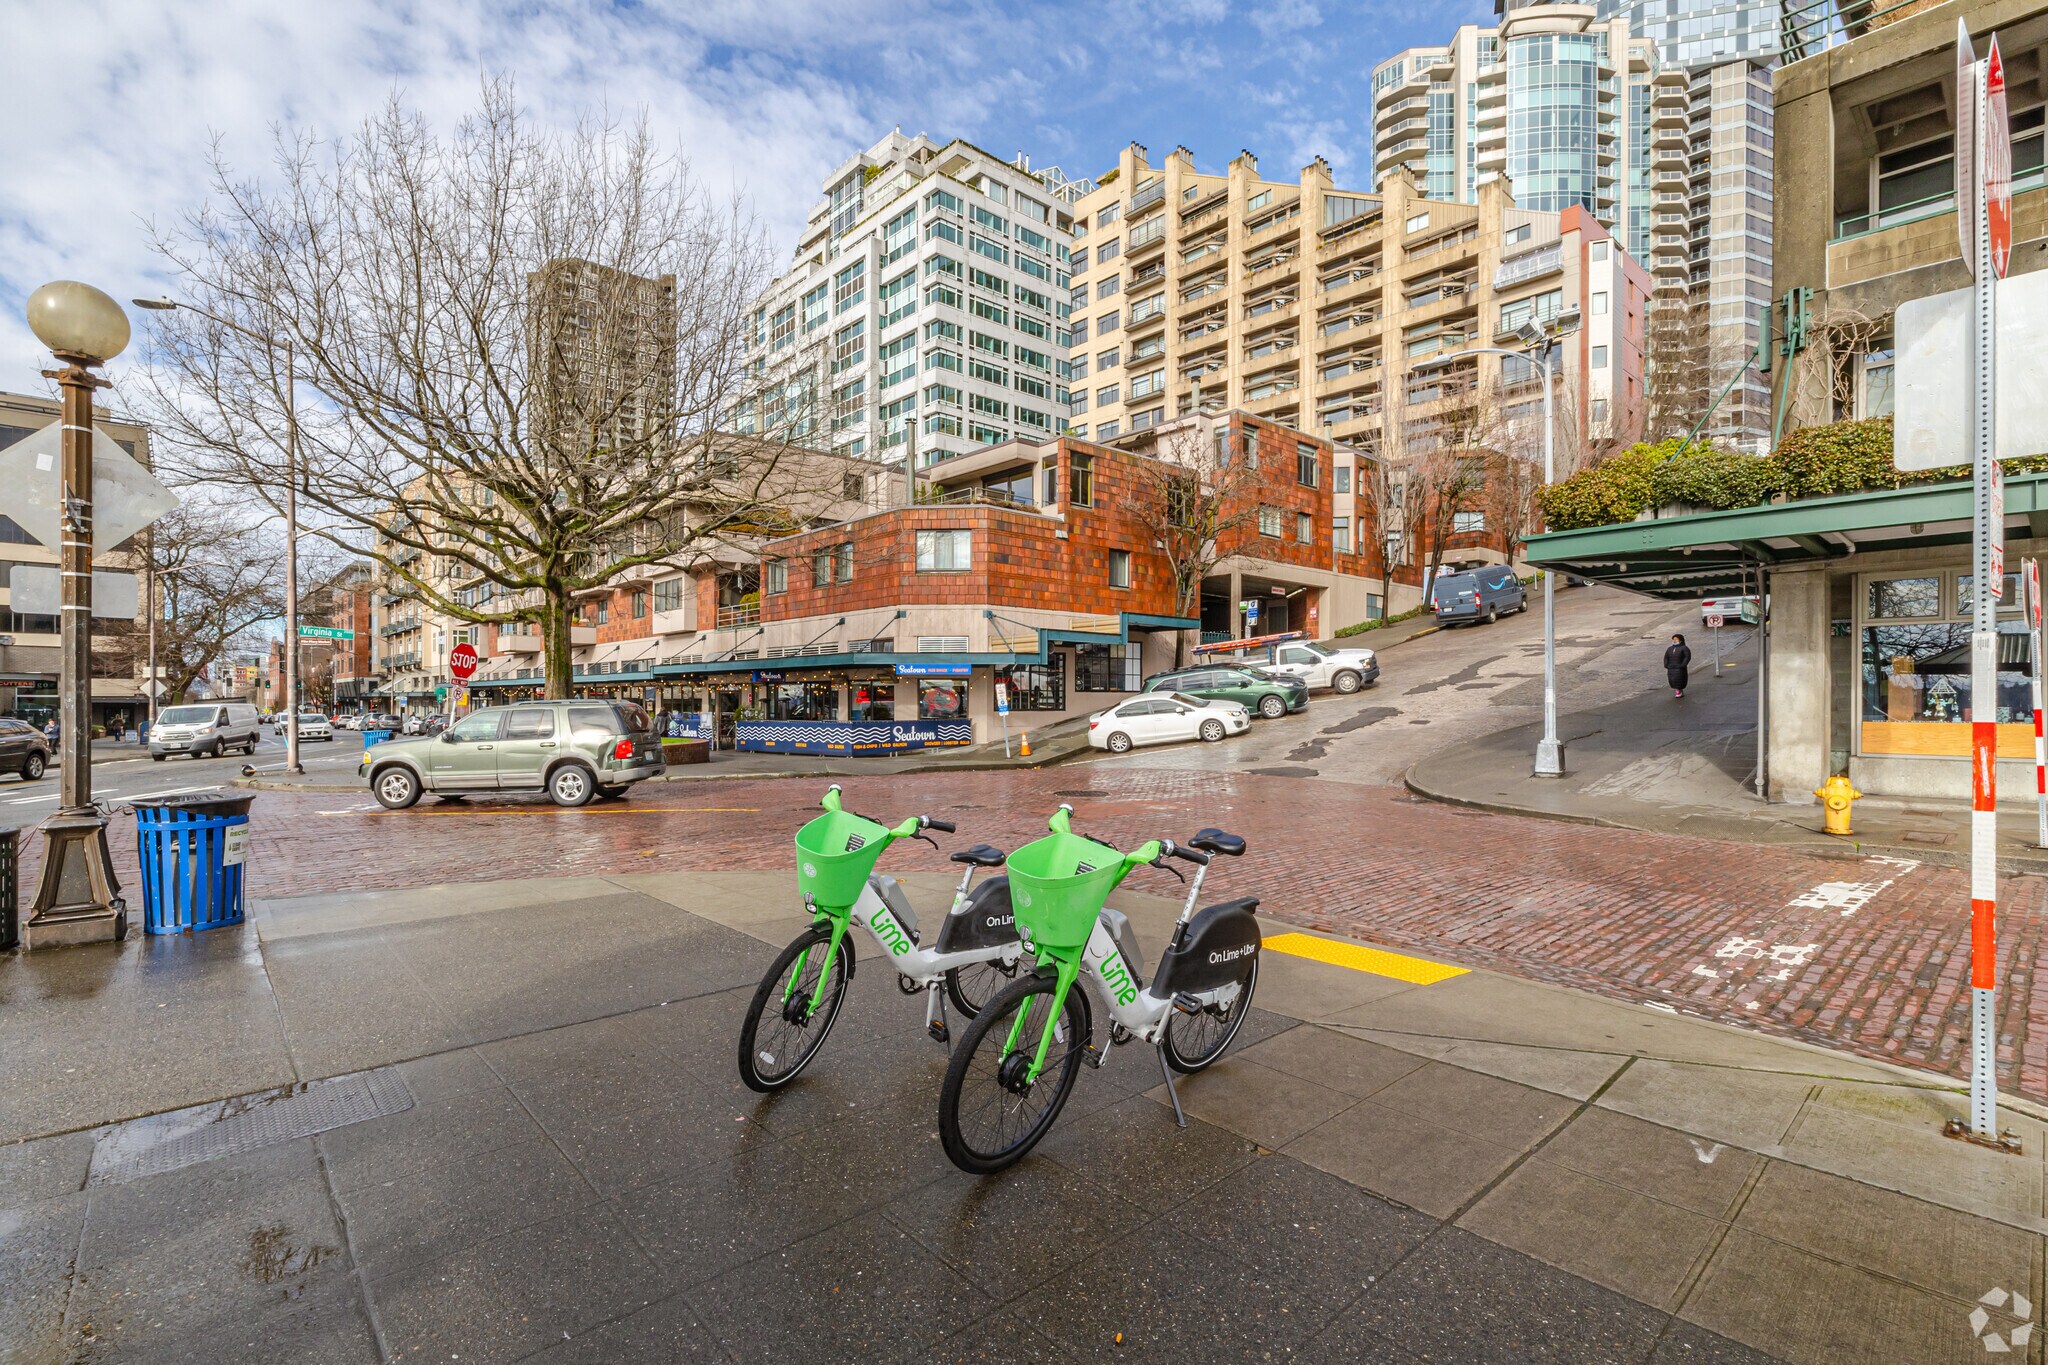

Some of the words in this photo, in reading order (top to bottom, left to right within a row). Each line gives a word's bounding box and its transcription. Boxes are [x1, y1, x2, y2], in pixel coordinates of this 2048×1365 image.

[1986, 96, 2009, 222] STOP
[302, 626, 332, 637] Virginia
[451, 652, 477, 669] STOP
[898, 664, 926, 674] Seatown
[892, 725, 937, 742] Seatown
[986, 916, 1000, 927] On
[1001, 914, 1015, 925] Lim
[870, 907, 910, 957] Lime
[1209, 952, 1222, 964] On
[1223, 949, 1239, 962] Lime
[1243, 944, 1256, 956] Uber
[1100, 950, 1137, 1007] Lime
